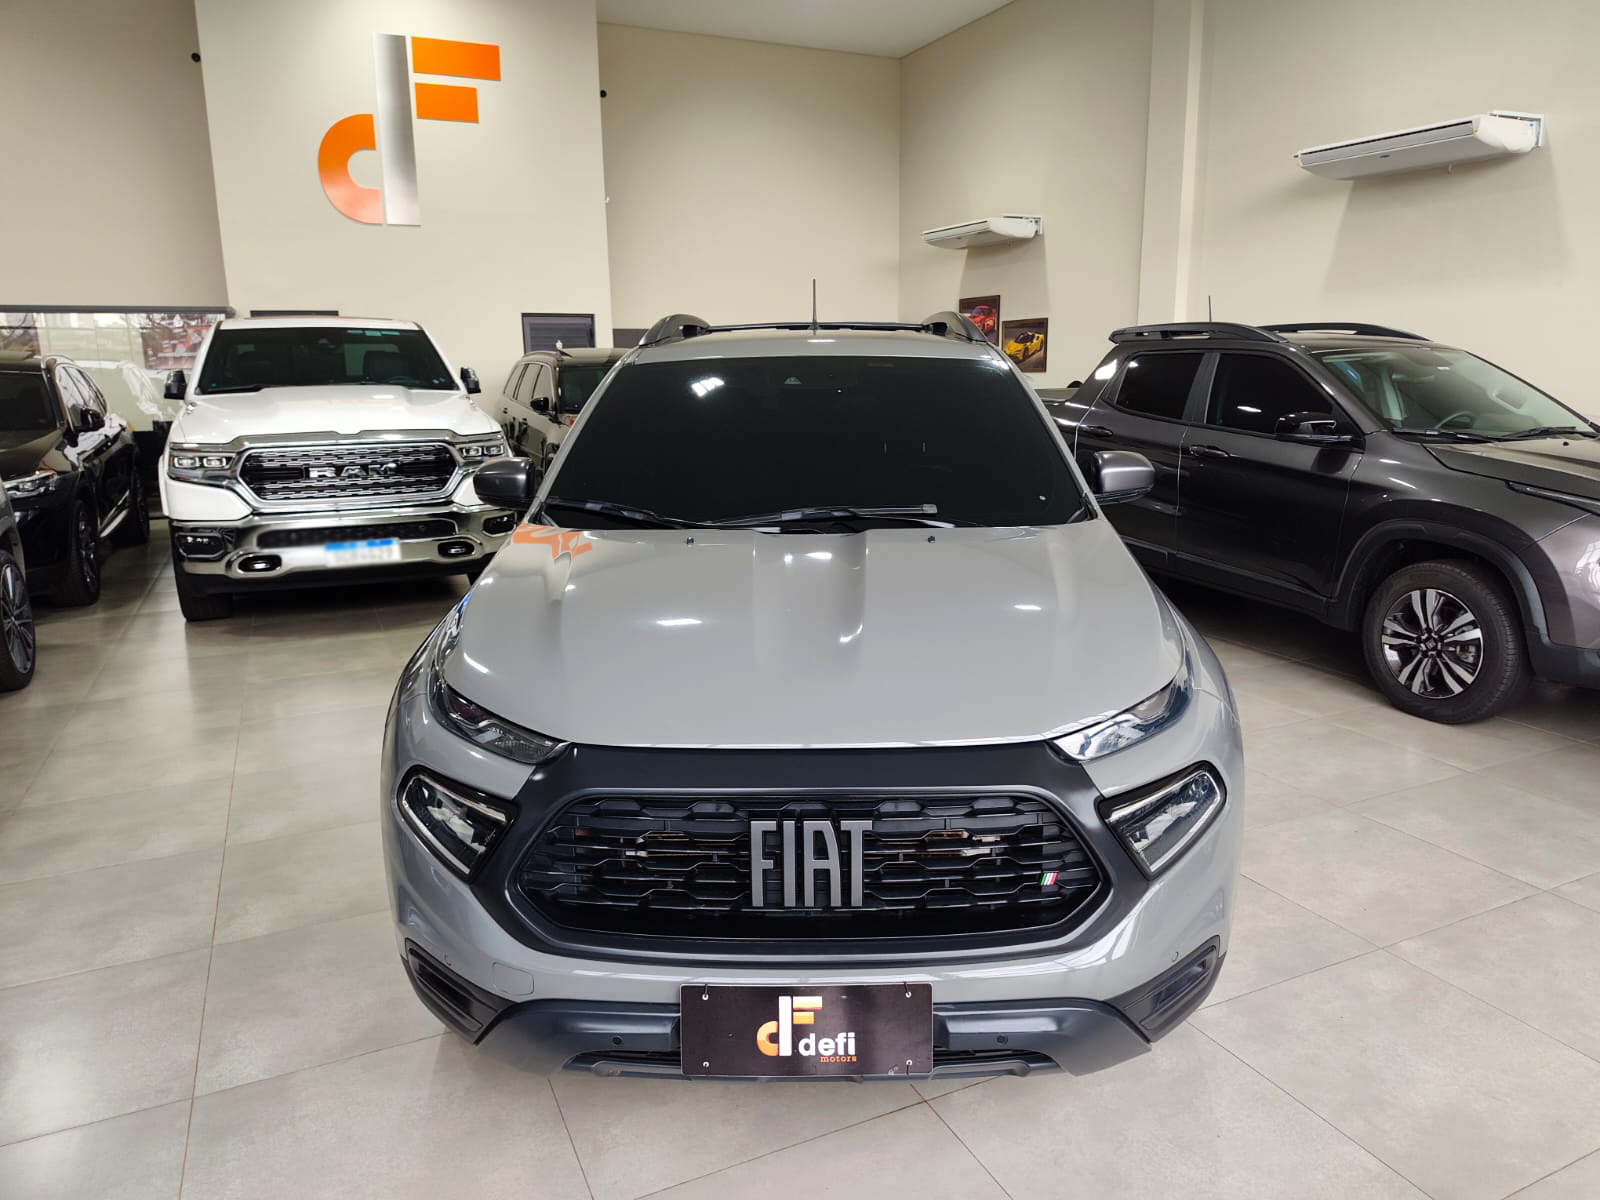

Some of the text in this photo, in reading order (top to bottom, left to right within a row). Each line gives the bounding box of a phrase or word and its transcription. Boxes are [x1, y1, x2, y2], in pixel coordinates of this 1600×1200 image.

[308, 462, 398, 479] RAM
[750, 820, 873, 907] FIAT
[798, 1032, 855, 1056] defi
